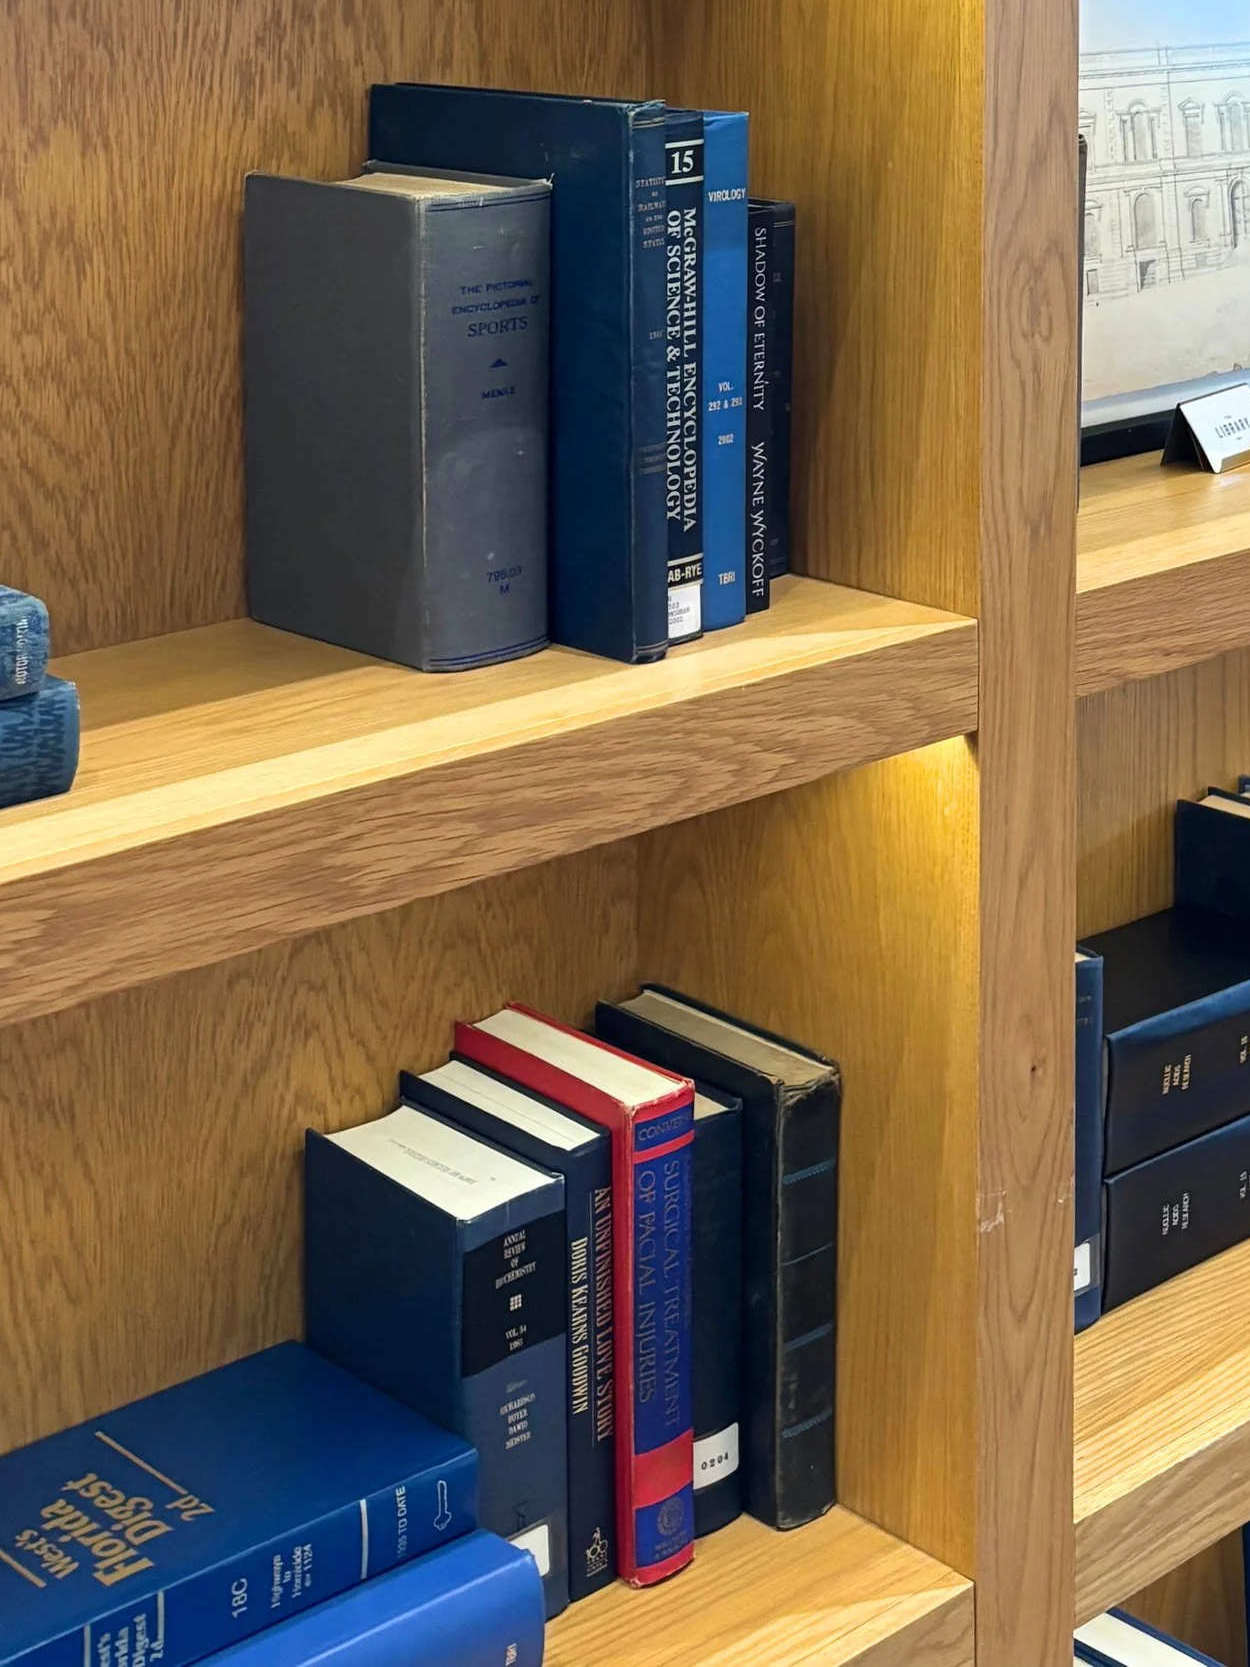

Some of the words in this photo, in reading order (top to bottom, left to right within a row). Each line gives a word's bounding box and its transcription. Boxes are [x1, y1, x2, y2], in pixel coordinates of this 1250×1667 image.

[671, 149, 694, 174] 15
[708, 188, 747, 203] VIROLOGY
[667, 210, 681, 239] OF
[683, 207, 697, 358] McGRAW-HILL
[754, 227, 767, 302] SHADOW
[451, 298, 527, 315] ENCYCLOPEDIA
[460, 285, 482, 295] THE
[666, 245, 681, 340] SCIENCE
[467, 316, 528, 337] SPORTS
[754, 306, 766, 328] OF
[666, 345, 681, 363] &
[753, 333, 769, 411] ETERNITY
[666, 365, 681, 520] TECHNOLOGY
[683, 362, 697, 532] ENCYCLOPEDIA
[1214, 417, 1250, 438] LIBRARY
[751, 442, 767, 507] WAYNE
[667, 563, 702, 583] AB-RYE
[750, 509, 767, 597] WYCKOFF
[594, 1186, 612, 1214] AN
[639, 1170, 656, 1203] OF
[664, 1160, 680, 1279] SURGICAL
[504, 1241, 526, 1259] REVIEW
[571, 1237, 588, 1284] DORIS
[595, 1213, 612, 1328] UNFINISHED
[639, 1211, 656, 1295] FACIAL
[571, 1284, 588, 1345] KEARNS
[596, 1327, 613, 1381] LOVE
[638, 1301, 657, 1404] INJURIES
[664, 1279, 680, 1428] TREATMENT
[571, 1345, 589, 1415] GOODWIN
[597, 1380, 613, 1441] STORY
[701, 1452, 729, 1471] 0204
[60, 1472, 174, 1546] Digest
[165, 1494, 215, 1522] 2d
[396, 1486, 408, 1515] DATE
[15, 1529, 79, 1579] West's
[40, 1498, 155, 1587] Florida
[232, 1578, 248, 1619] 18C
[282, 1571, 291, 1583] to
[150, 1640, 164, 1662] 2d
